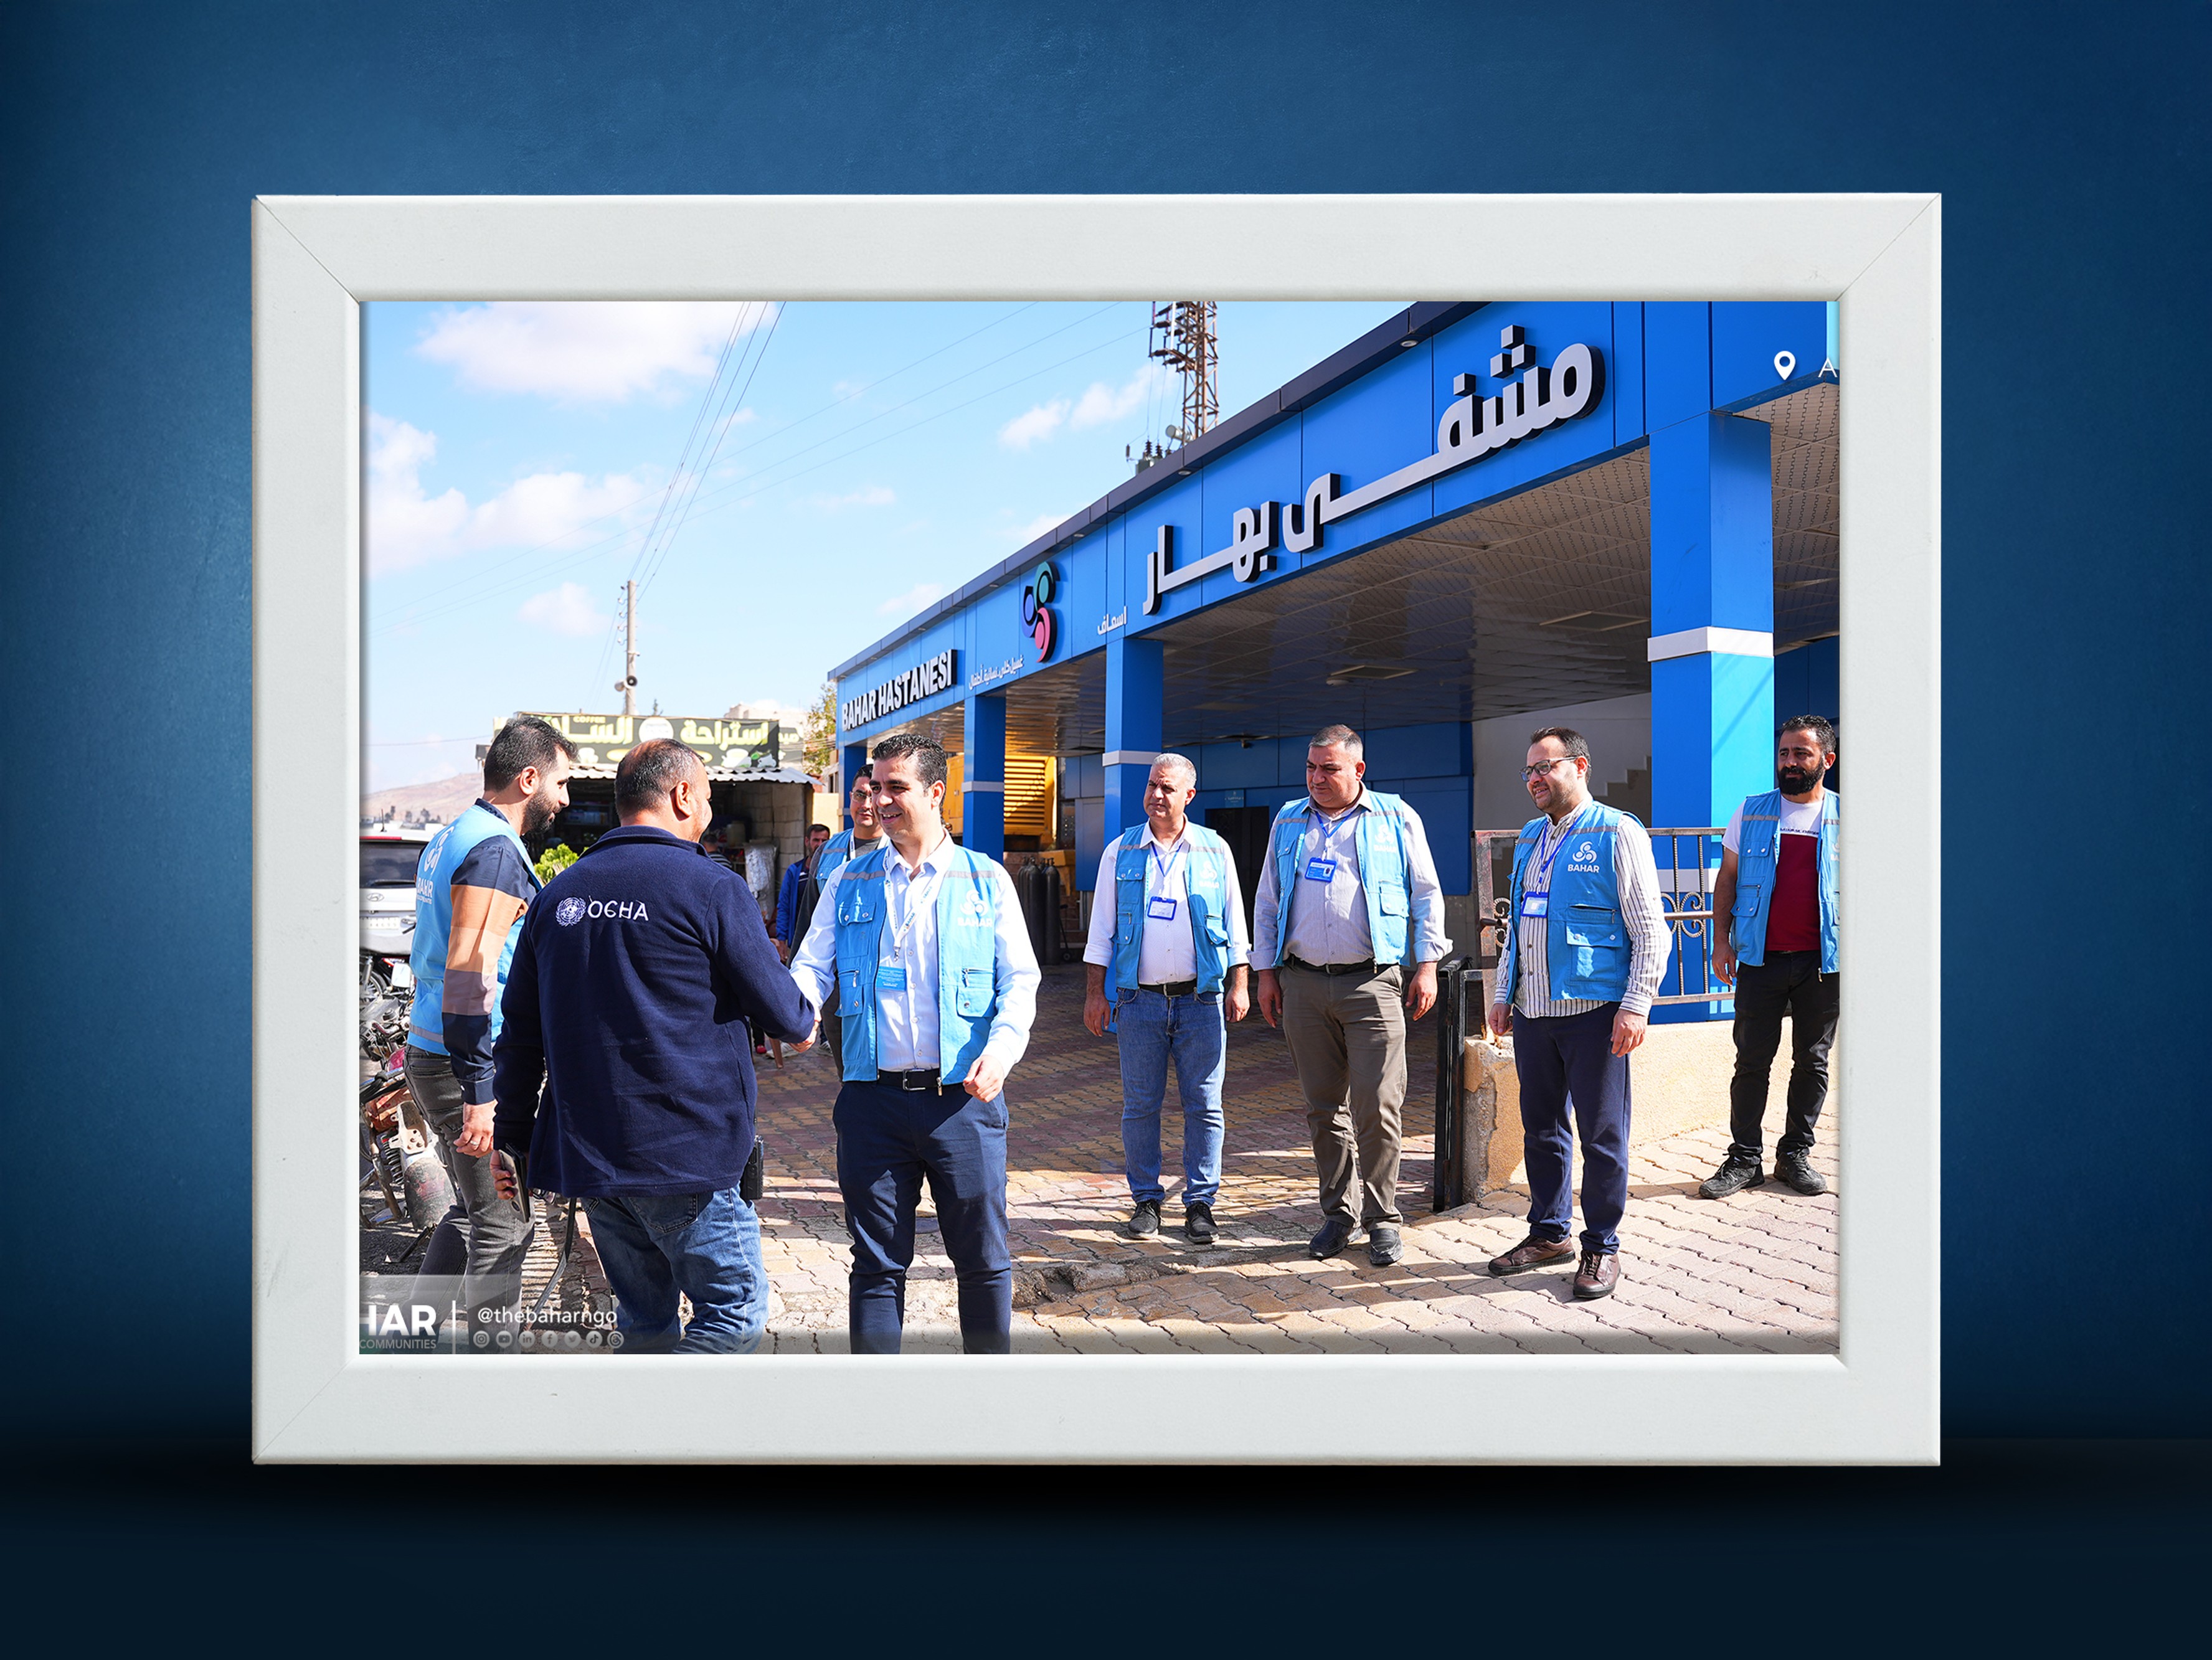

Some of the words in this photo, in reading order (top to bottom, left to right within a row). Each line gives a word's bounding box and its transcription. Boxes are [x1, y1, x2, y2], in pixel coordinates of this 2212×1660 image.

[1282, 324, 1595, 553] مشفى
[1142, 501, 1273, 615] بهار
[842, 689, 877, 732] BAHAR
[878, 649, 952, 717] HASTANESI
[679, 720, 769, 751] استراحة
[1567, 864, 1600, 873] BAHAR
[587, 900, 649, 921] OCHA
[957, 917, 993, 927] BAHAR
